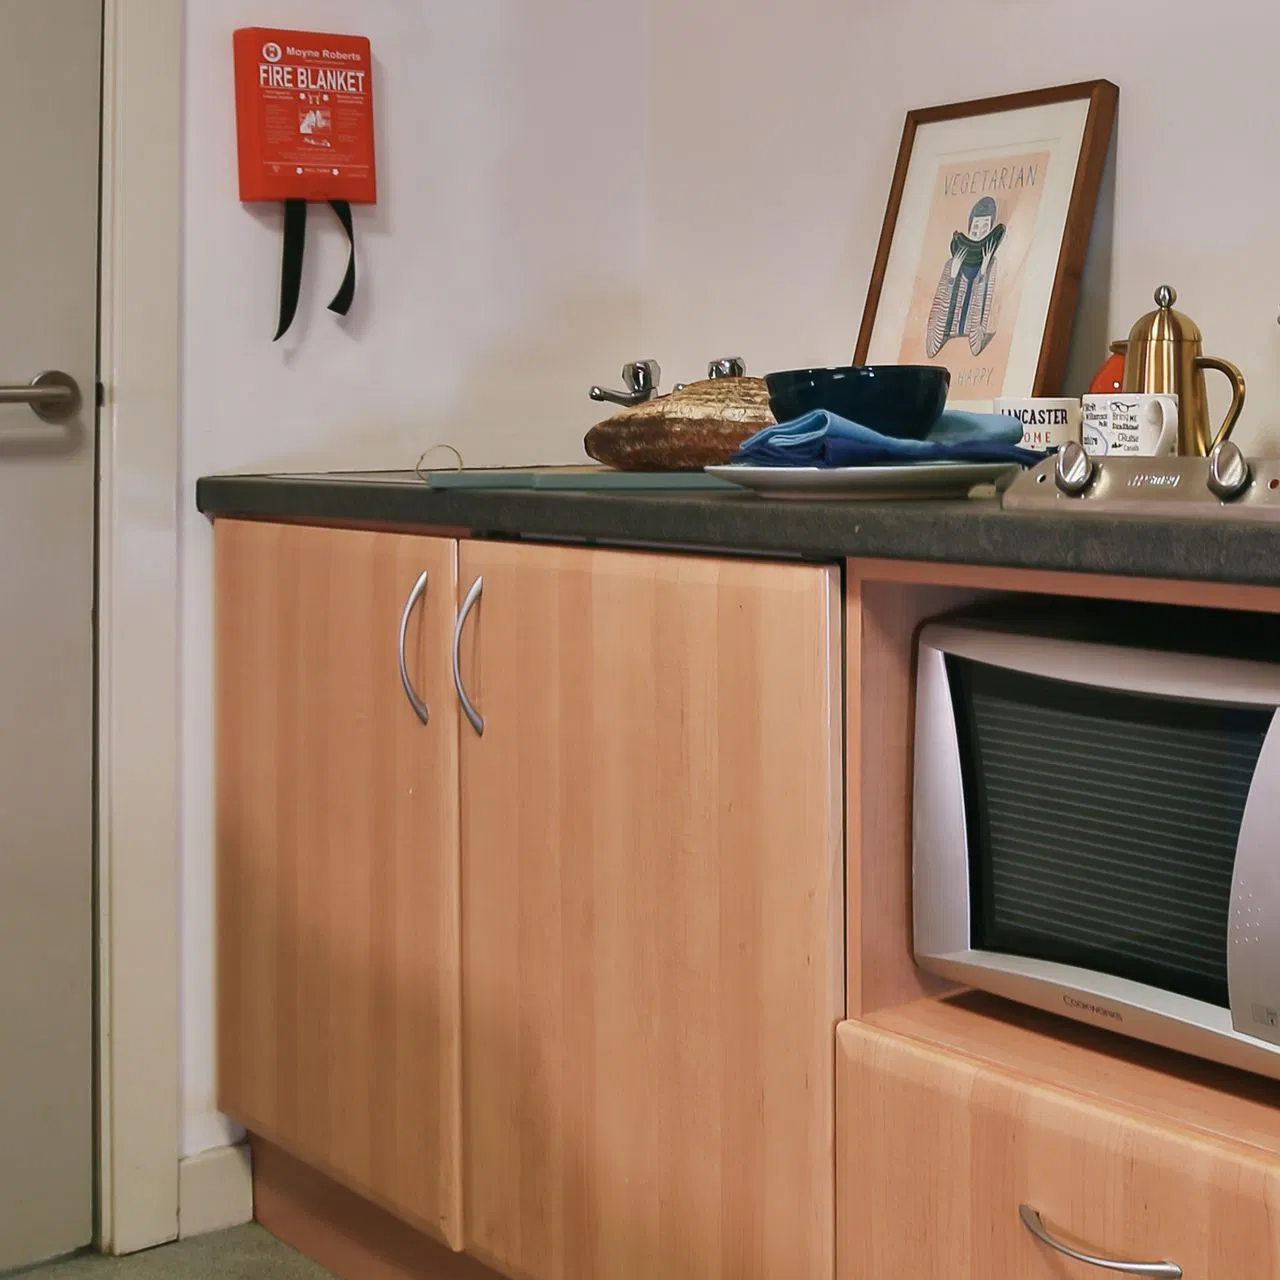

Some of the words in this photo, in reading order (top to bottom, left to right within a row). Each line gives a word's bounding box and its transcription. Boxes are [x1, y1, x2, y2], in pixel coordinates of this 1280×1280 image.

[286, 46, 320, 59] Moyne
[322, 49, 361, 61] Roberts
[260, 65, 294, 88] FIRE
[297, 67, 365, 93] BLANKET
[944, 163, 1039, 197] VEGETARIAN
[957, 367, 994, 387] HAPPY
[1023, 431, 1052, 443] OME
